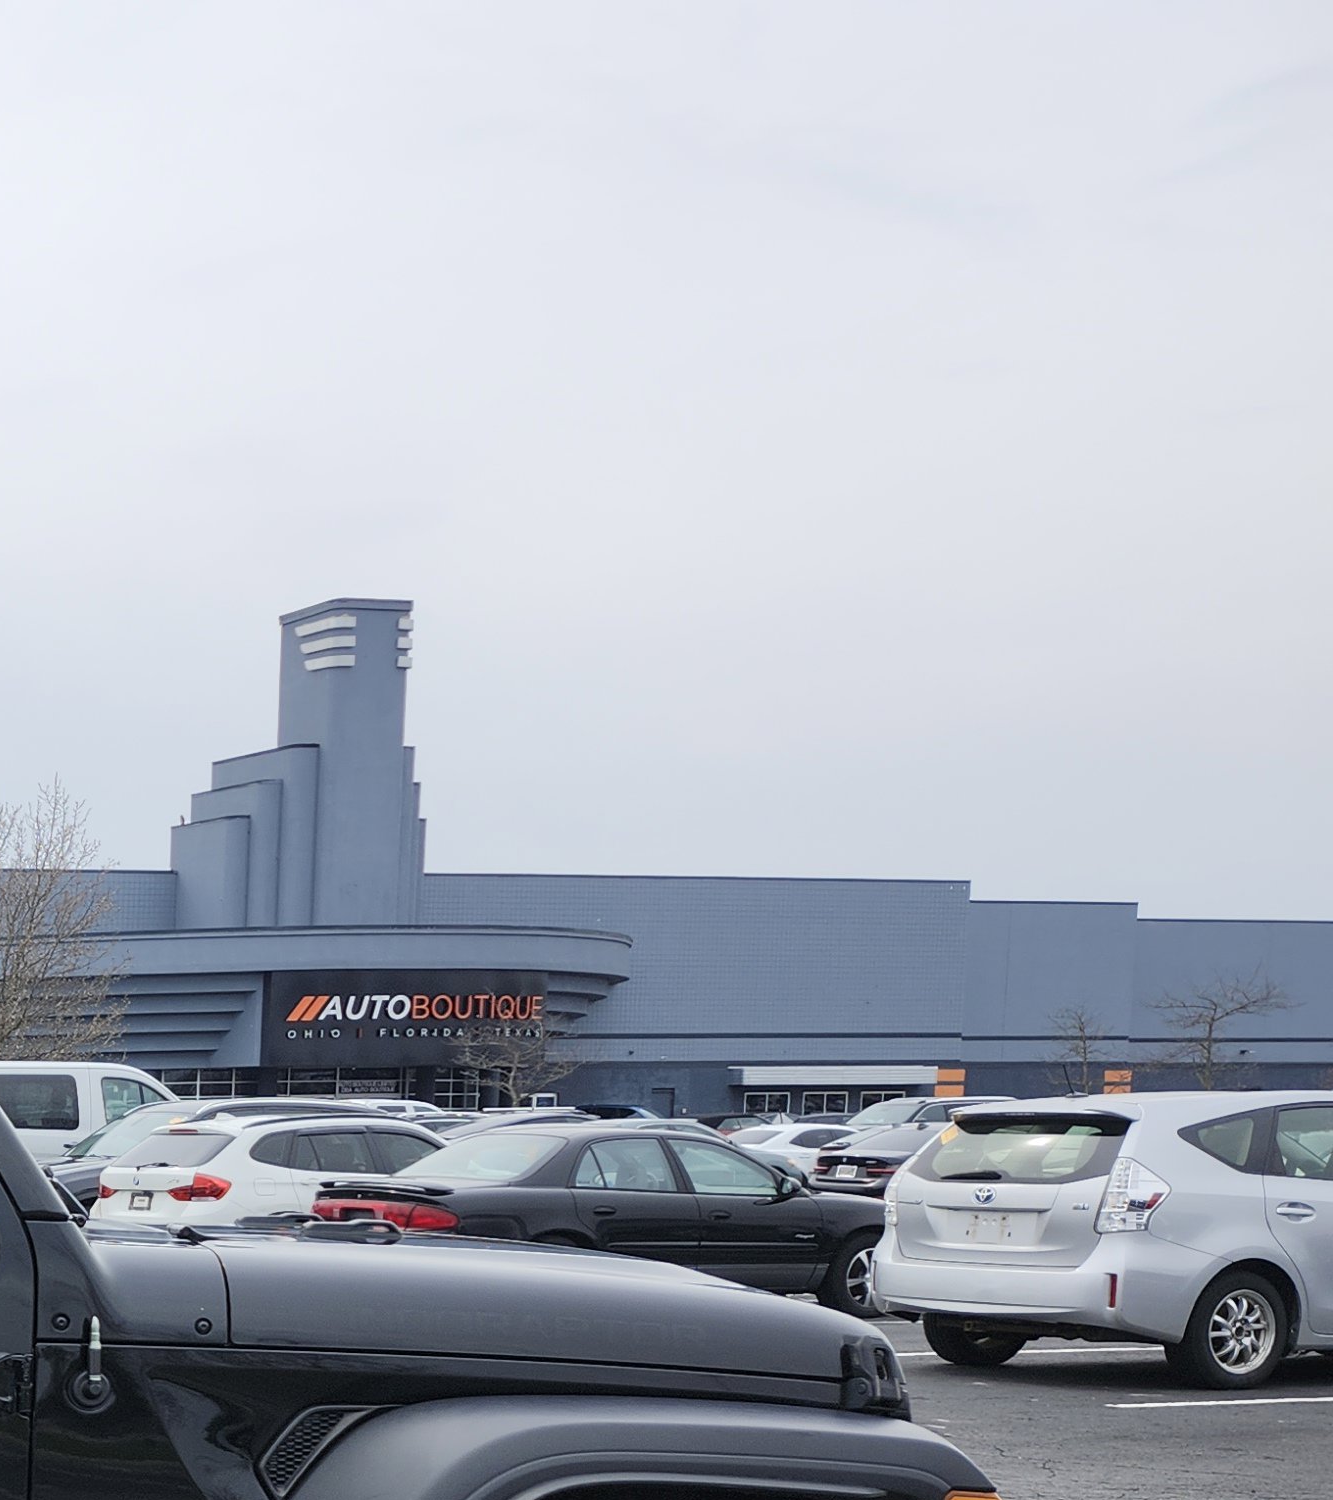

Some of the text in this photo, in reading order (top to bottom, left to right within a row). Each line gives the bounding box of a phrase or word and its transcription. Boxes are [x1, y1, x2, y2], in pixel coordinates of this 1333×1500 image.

[287, 1027, 542, 1039] OHIO FLORIDA TEXAS
